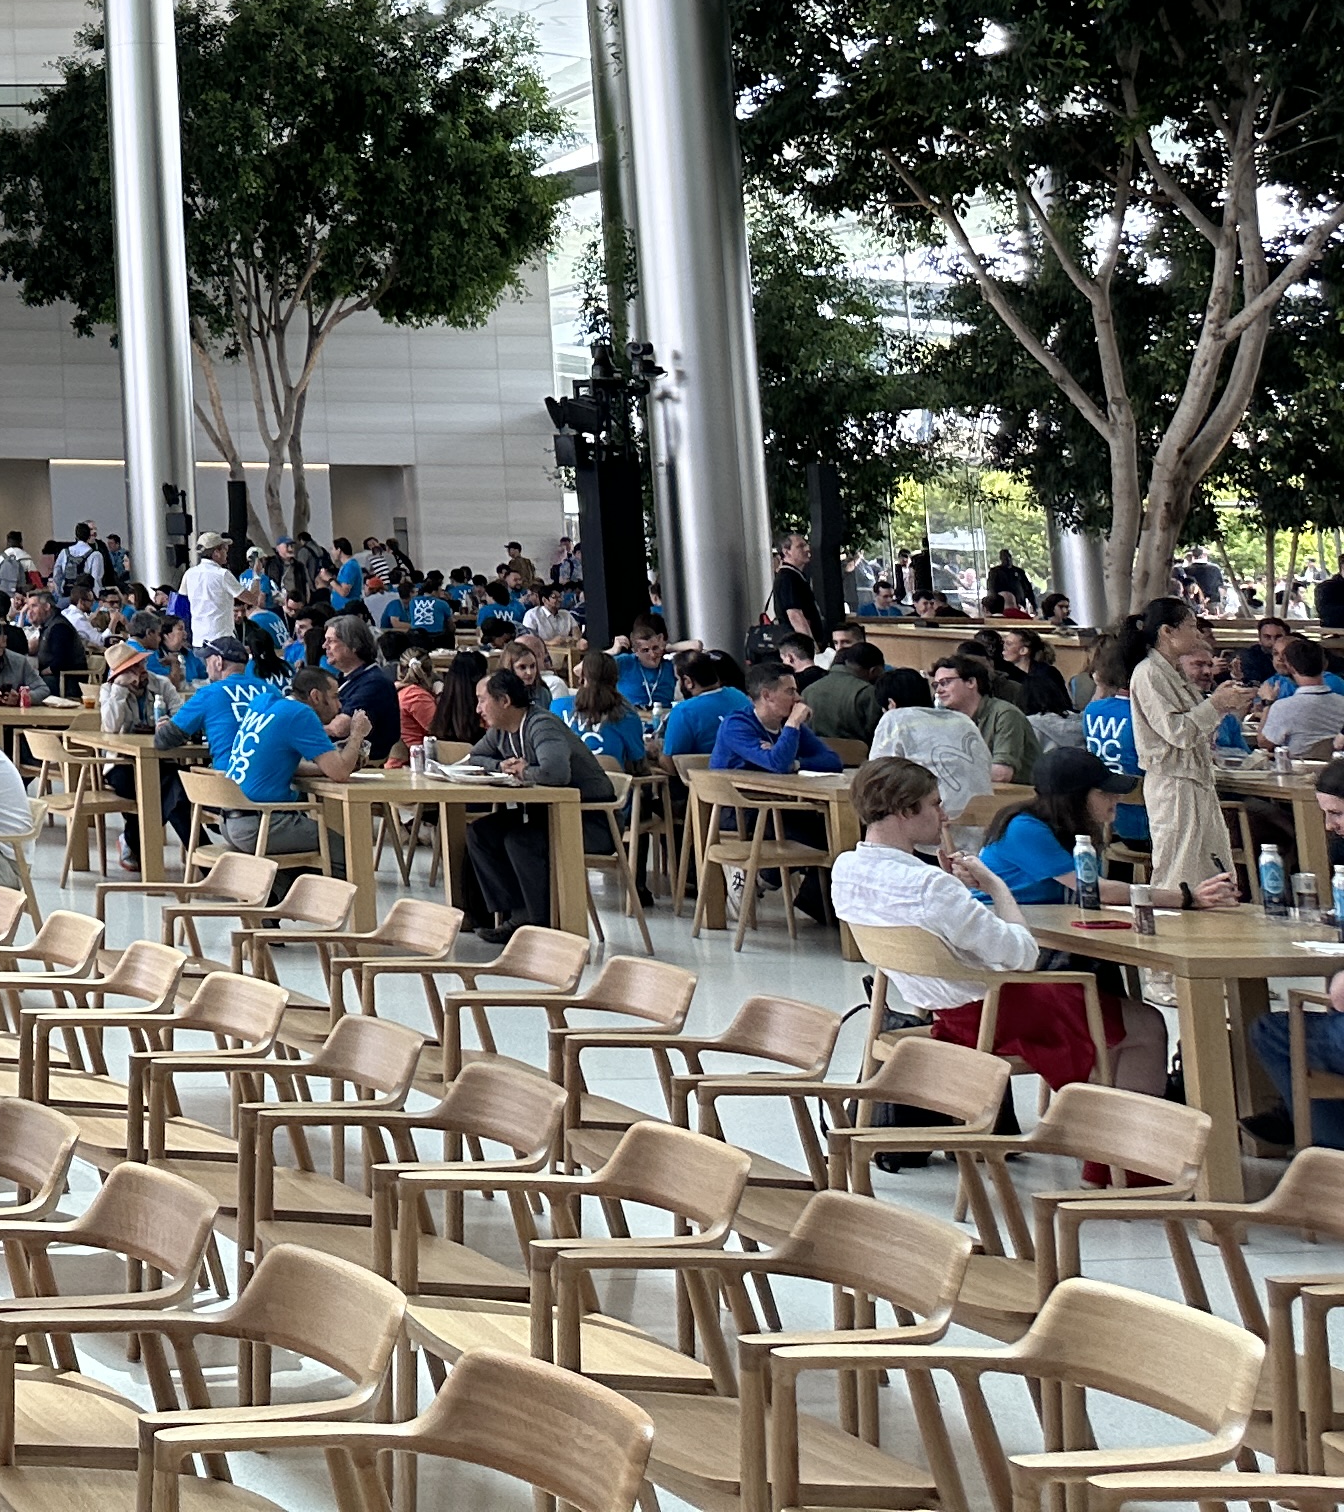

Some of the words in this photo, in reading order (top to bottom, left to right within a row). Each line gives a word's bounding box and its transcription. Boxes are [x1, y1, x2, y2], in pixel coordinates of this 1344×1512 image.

[414, 599, 436, 609] WW
[414, 607, 435, 617] DC
[414, 615, 435, 626] 23
[239, 708, 276, 734] WW
[1086, 714, 1128, 740] WW
[231, 729, 260, 758] DC
[1086, 735, 1122, 762] DC
[225, 755, 250, 785] 23
